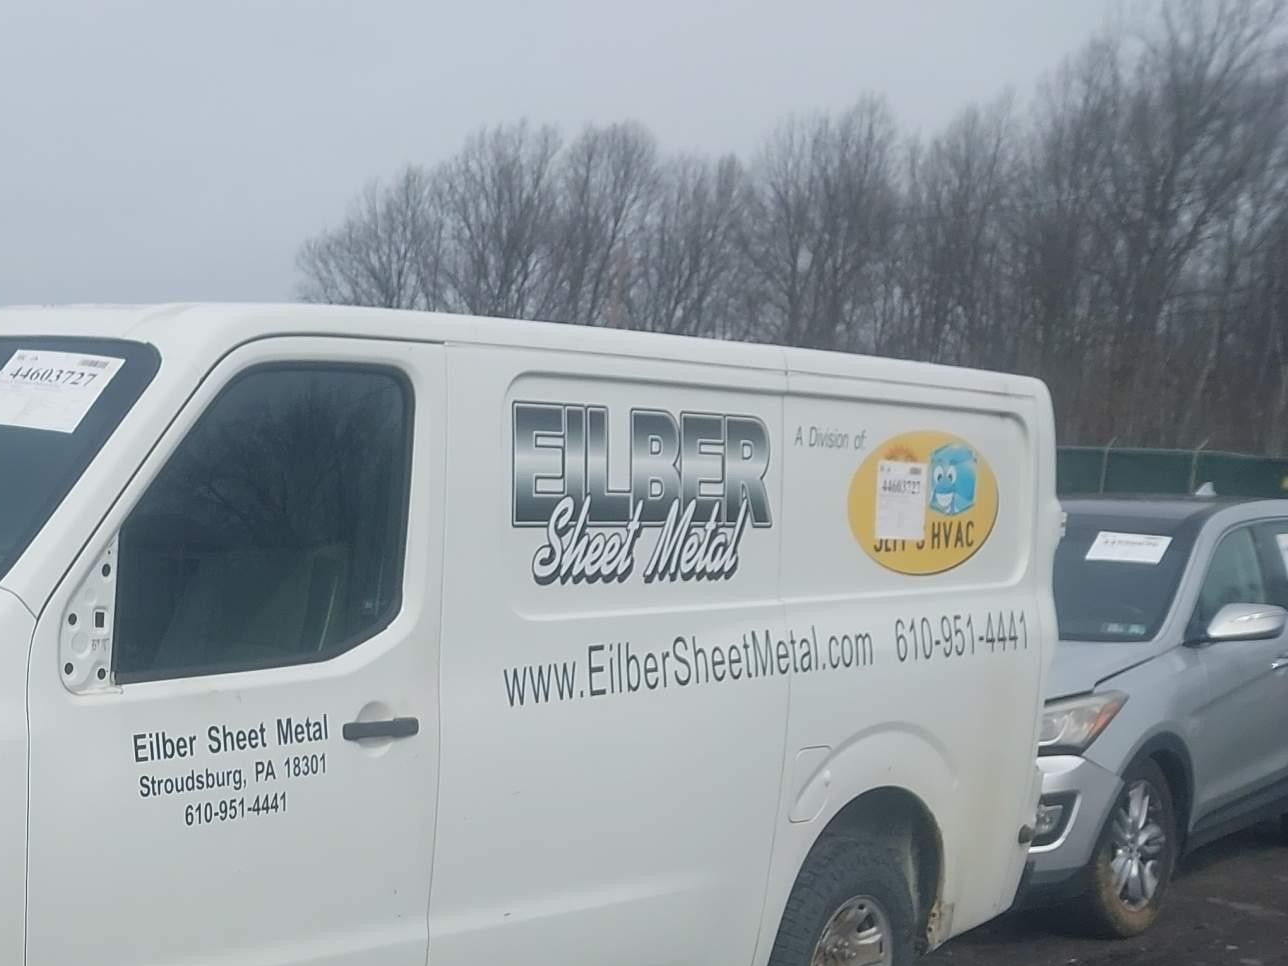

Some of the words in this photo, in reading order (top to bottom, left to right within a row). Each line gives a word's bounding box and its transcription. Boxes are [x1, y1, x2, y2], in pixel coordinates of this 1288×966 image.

[10, 366, 98, 387] 44603727
[794, 426, 803, 446] A
[809, 426, 848, 448] Division
[512, 401, 772, 528] EILBER
[532, 496, 643, 585] Sheet
[643, 497, 748, 584] Metal
[931, 520, 975, 549] HVAC
[504, 626, 874, 708] www.EilberSheetMetal.com
[894, 610, 1029, 664] 610-951-4441
[133, 731, 197, 762] Eilber
[207, 721, 267, 754] Sheet
[276, 713, 329, 746] Metal
[139, 768, 247, 798] Stroudsburg,
[255, 760, 276, 782] PA
[284, 753, 327, 778] 18301
[185, 792, 287, 826] 610-951-4441
